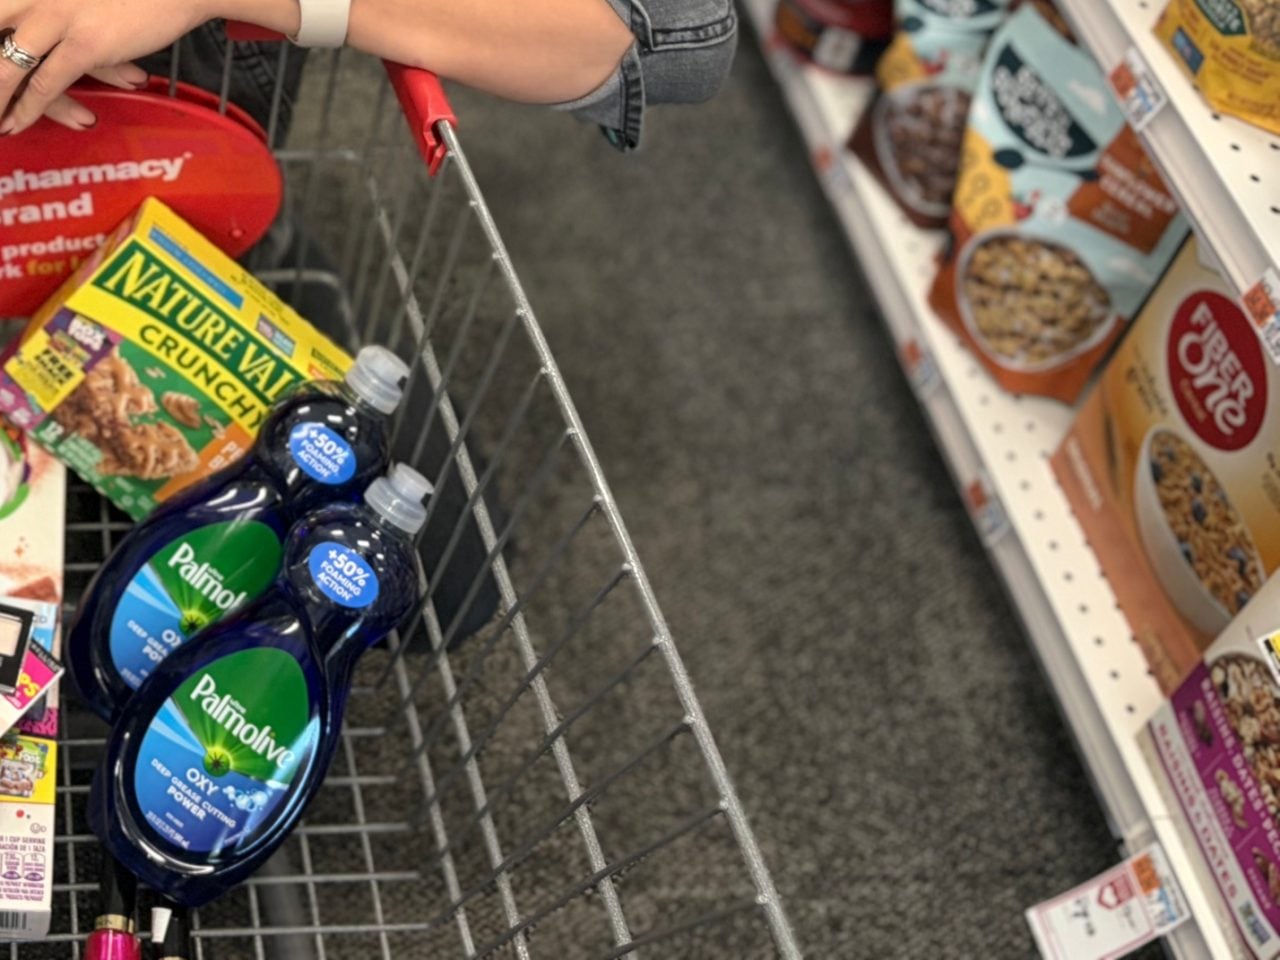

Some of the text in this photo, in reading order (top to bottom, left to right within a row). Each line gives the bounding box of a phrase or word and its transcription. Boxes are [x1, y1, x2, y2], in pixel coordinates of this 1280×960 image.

[26, 259, 65, 276] for
[103, 250, 246, 360] NATURE
[40, 348, 74, 379] FREE
[1190, 301, 1254, 407] FIBER
[1178, 331, 1246, 434] One
[300, 440, 340, 474] FOAMING
[309, 428, 349, 466] +50%
[320, 560, 361, 597] FOAMING
[328, 549, 370, 587] +50%
[127, 620, 148, 638] DEEP
[189, 673, 295, 769] Palmolive
[151, 758, 173, 778] DEEP
[186, 768, 220, 796] OXY
[167, 786, 207, 821] POWER
[171, 776, 202, 802] GREASE
[201, 801, 237, 829] CUTTING
